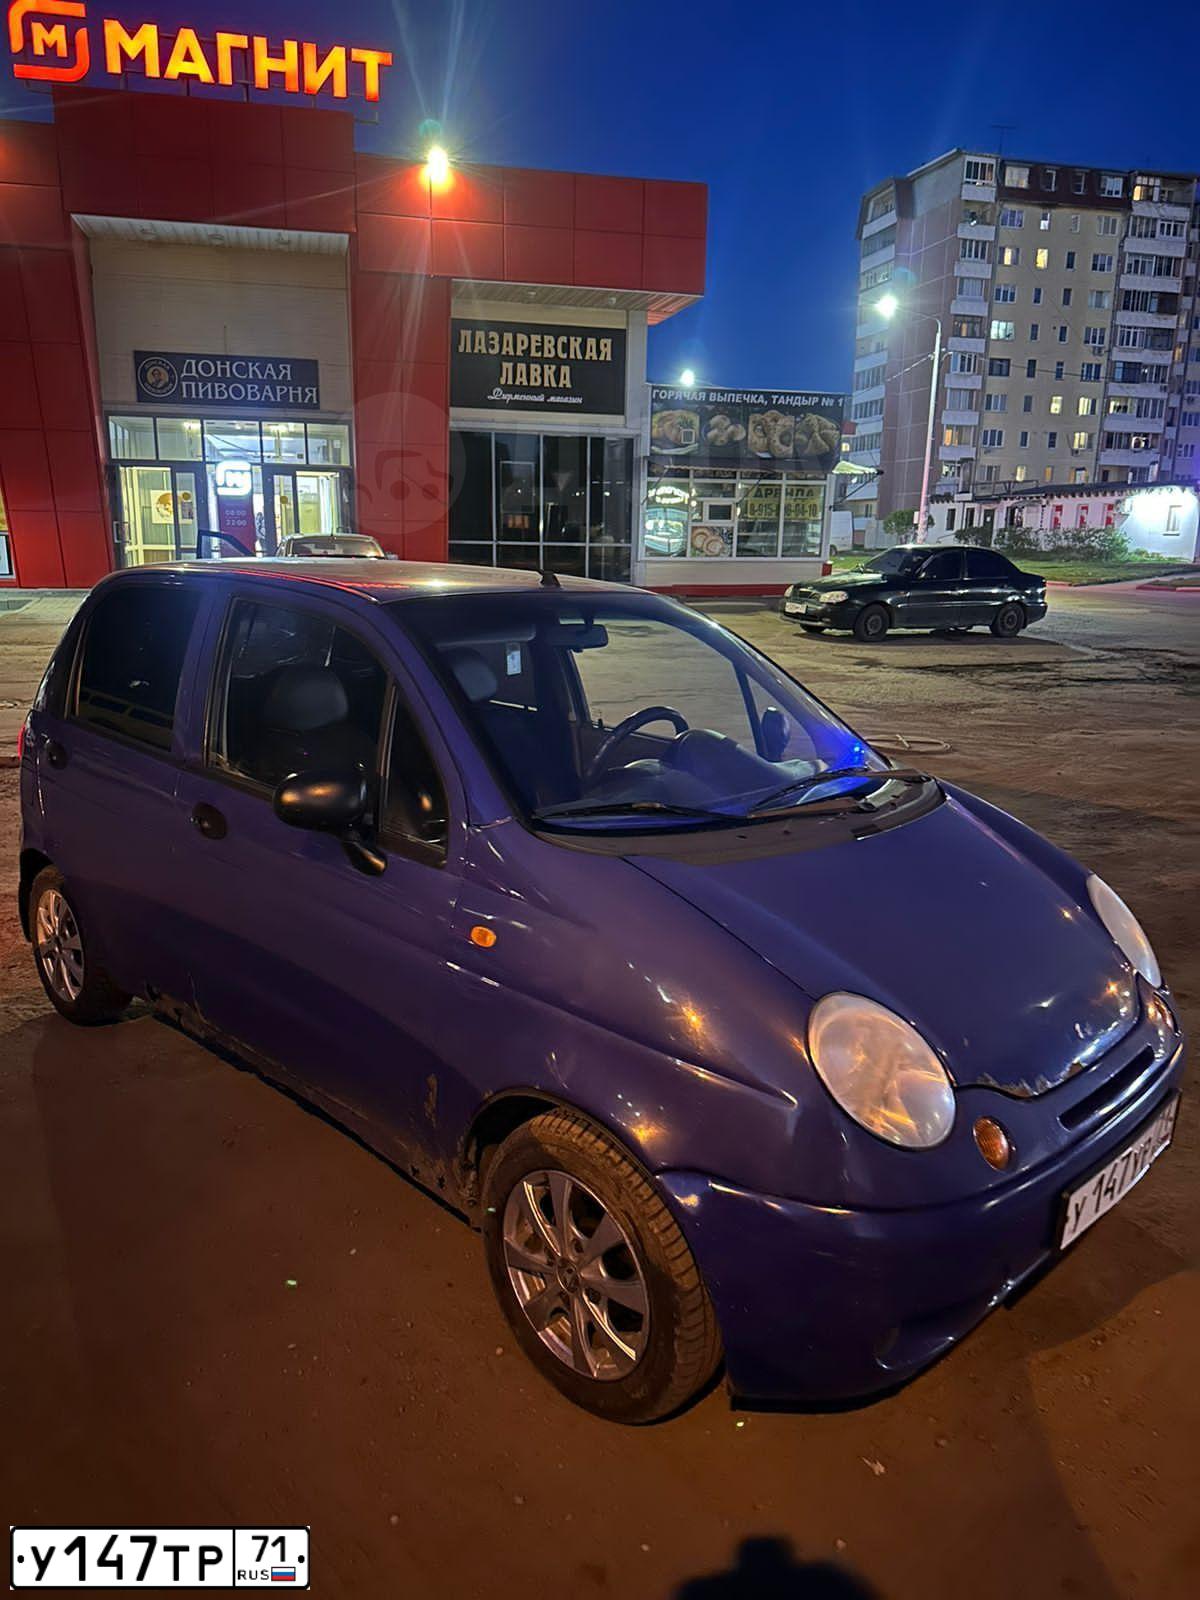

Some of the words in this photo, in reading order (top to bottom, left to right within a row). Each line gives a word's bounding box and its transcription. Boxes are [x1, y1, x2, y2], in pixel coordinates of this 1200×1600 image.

[104, 19, 392, 102] МАГНИТ
[458, 329, 612, 361] ЛАЗАРЕВСКАЯ
[181, 359, 292, 380] ДОНСКАЯ
[500, 362, 572, 388] ЛАВКА
[182, 382, 318, 404] ПИВОВАРНЯ
[652, 389, 706, 401] ГОРЯЧАЯ
[709, 392, 768, 406] ВЫПЕЧКА,
[771, 394, 819, 408] ТАНДЫР
[837, 398, 843, 407] 1
